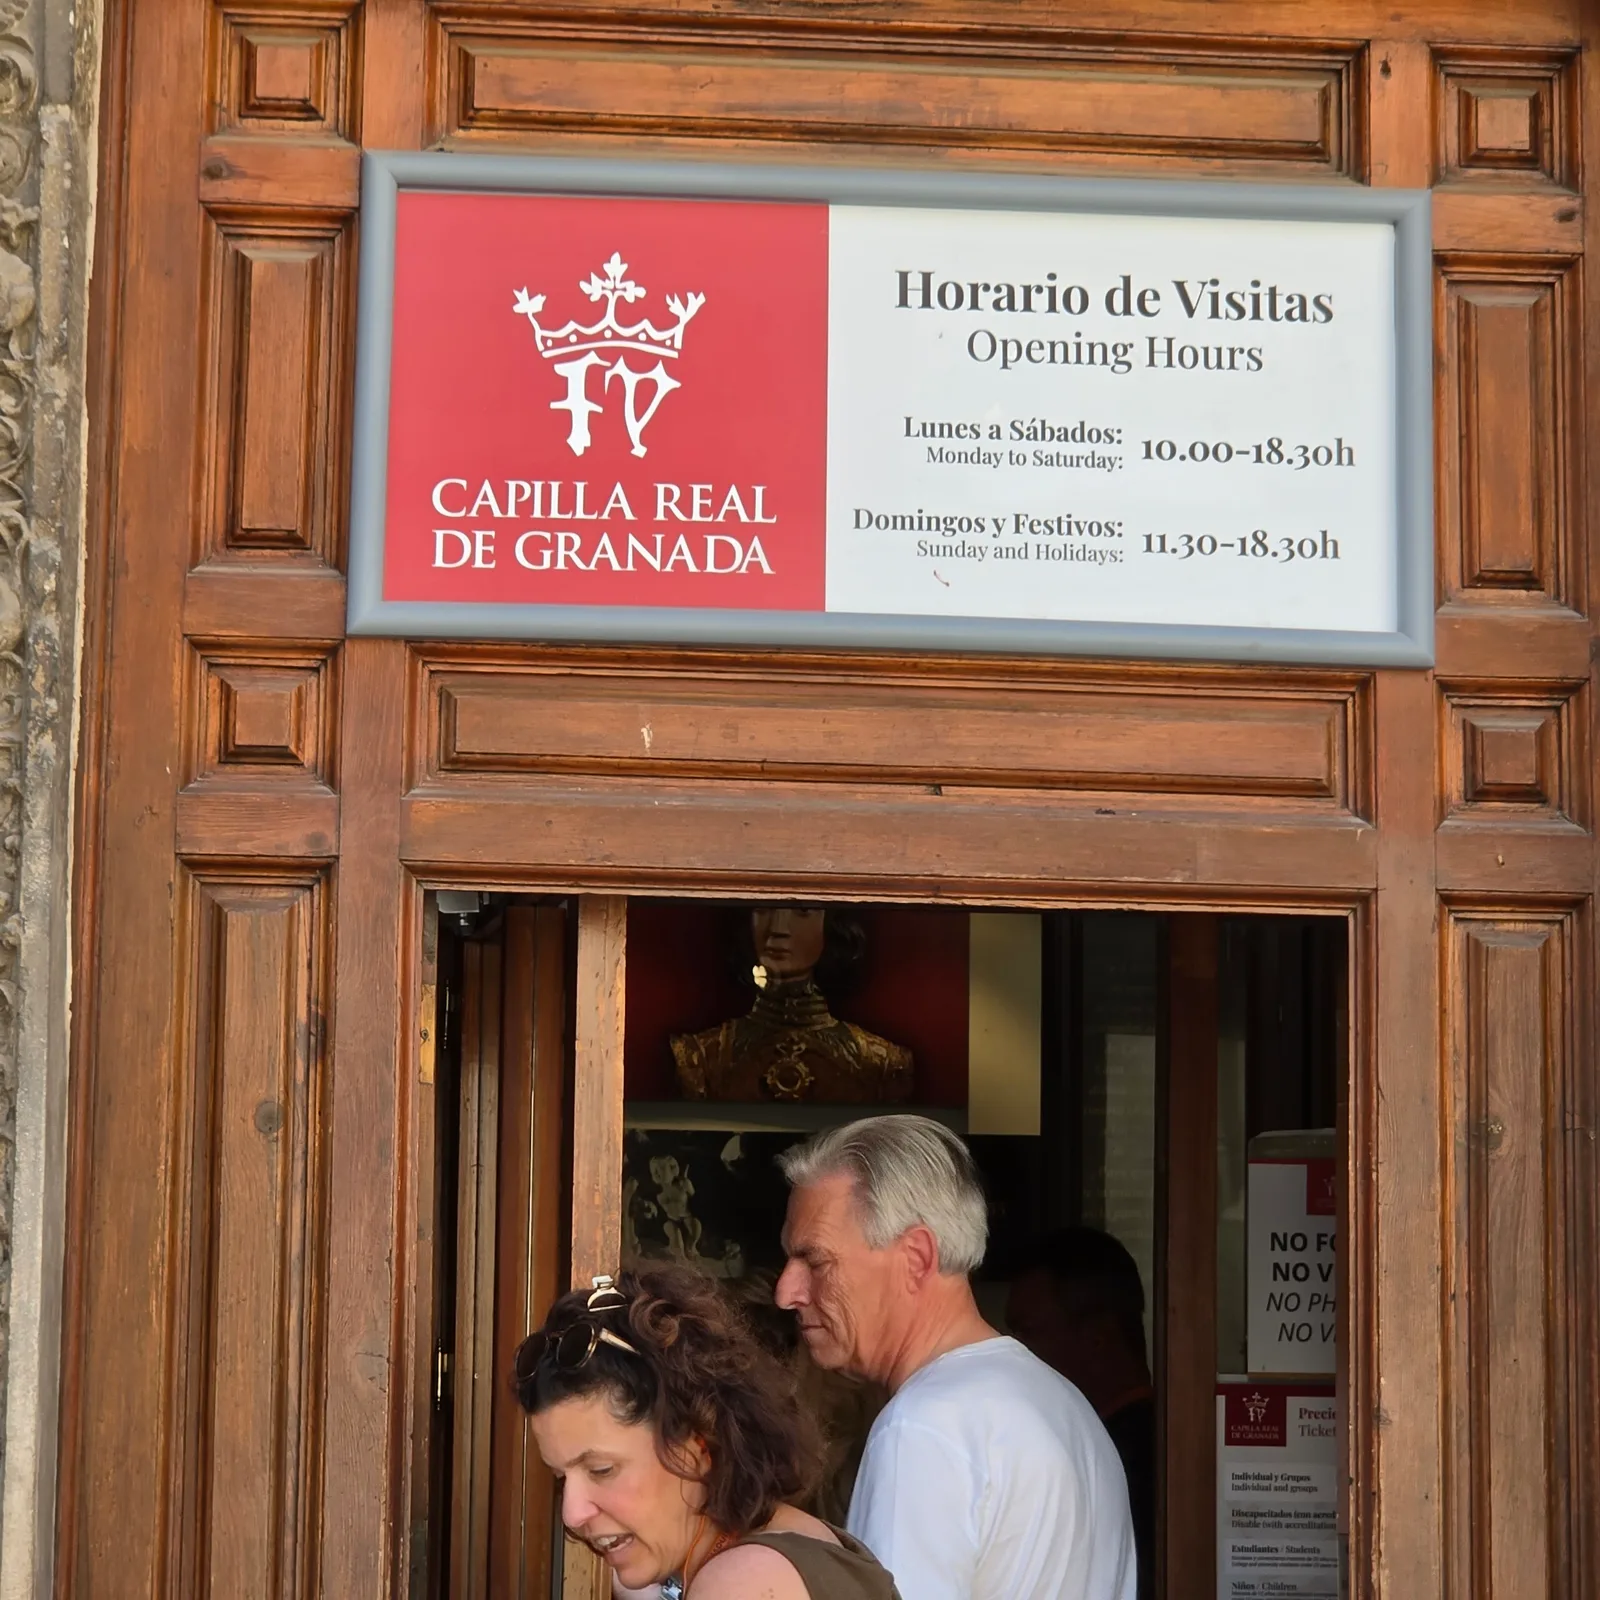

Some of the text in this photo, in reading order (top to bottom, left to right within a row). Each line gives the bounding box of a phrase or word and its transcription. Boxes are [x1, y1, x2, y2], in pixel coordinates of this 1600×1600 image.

[896, 271, 1334, 324] Horario de Visitas
[967, 330, 1263, 374] Opening Hours
[904, 417, 1123, 445] Lunes a Sábados:
[926, 447, 1123, 472] Monday to Saturday:
[1141, 437, 1355, 470] 10.00-18.30h
[431, 478, 777, 523] CAPILLA REAL
[853, 508, 1123, 538] Domingos y Festivos:
[432, 530, 775, 574] DE GRANADA
[917, 540, 1124, 565] Sunday and Holidays:
[1142, 529, 1340, 563] 11.30-18.30h
[1271, 1232, 1307, 1252] NO
[1273, 1262, 1310, 1282] NO
[1266, 1292, 1301, 1313] NO
[1277, 1322, 1336, 1344] NO V
[1231, 1472, 1272, 1481] Individual
[1280, 1473, 1311, 1482] Grupos
[1231, 1483, 1318, 1494] Individual and groups
[1231, 1545, 1279, 1553] Estudiantes
[1285, 1545, 1321, 1554] Students
[1261, 1582, 1297, 1591] Children
